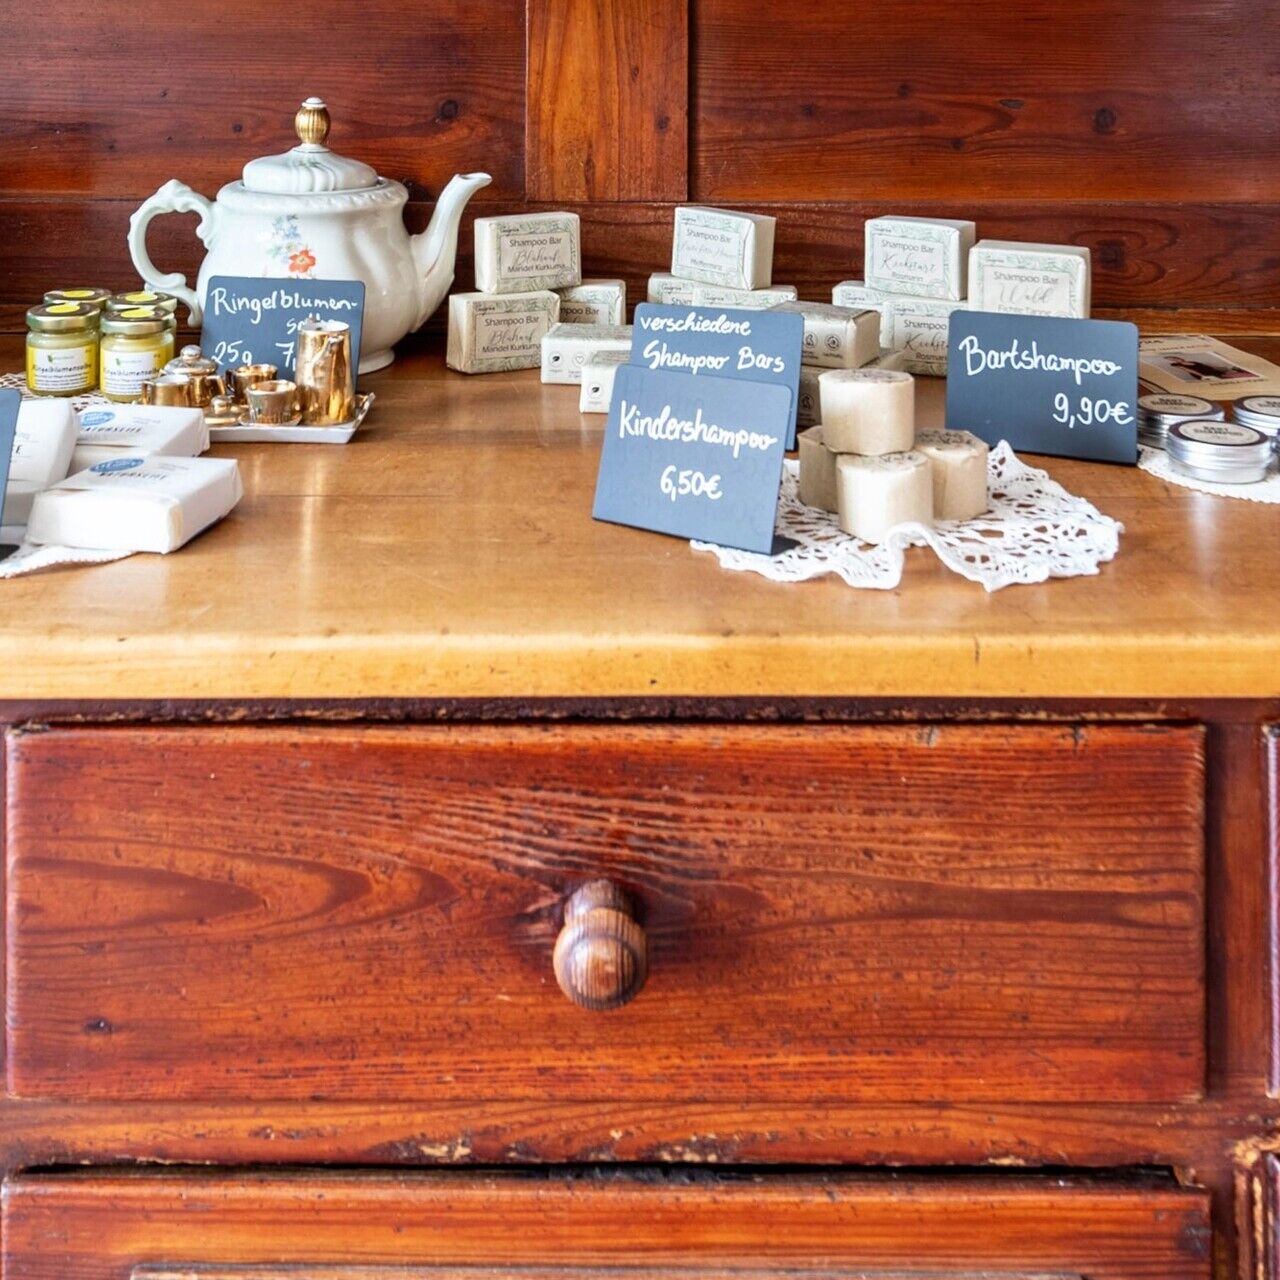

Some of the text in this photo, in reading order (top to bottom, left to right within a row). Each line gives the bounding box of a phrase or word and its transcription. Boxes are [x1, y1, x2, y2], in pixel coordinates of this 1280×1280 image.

[509, 237, 562, 248] Shampoo Bar
[686, 228, 732, 243] Shampoo Bar
[881, 239, 934, 253] Shampoo Bar
[508, 263, 566, 272] Mandel Kurkuma
[993, 270, 1059, 284] Shampoo Bar
[210, 288, 358, 324] Ringelblumen-
[584, 306, 599, 314] Bar
[485, 315, 540, 328] Shampoo Bar
[640, 311, 752, 336] verschiedene
[904, 319, 947, 330] Shampoo
[482, 344, 509, 353] Mandel
[643, 340, 785, 374] Shampoo Bars
[959, 335, 1122, 385] Bartshampoo
[1052, 392, 1134, 429] 9,90€
[619, 401, 779, 458] Kindershampoo
[660, 467, 723, 500] 6,50€
